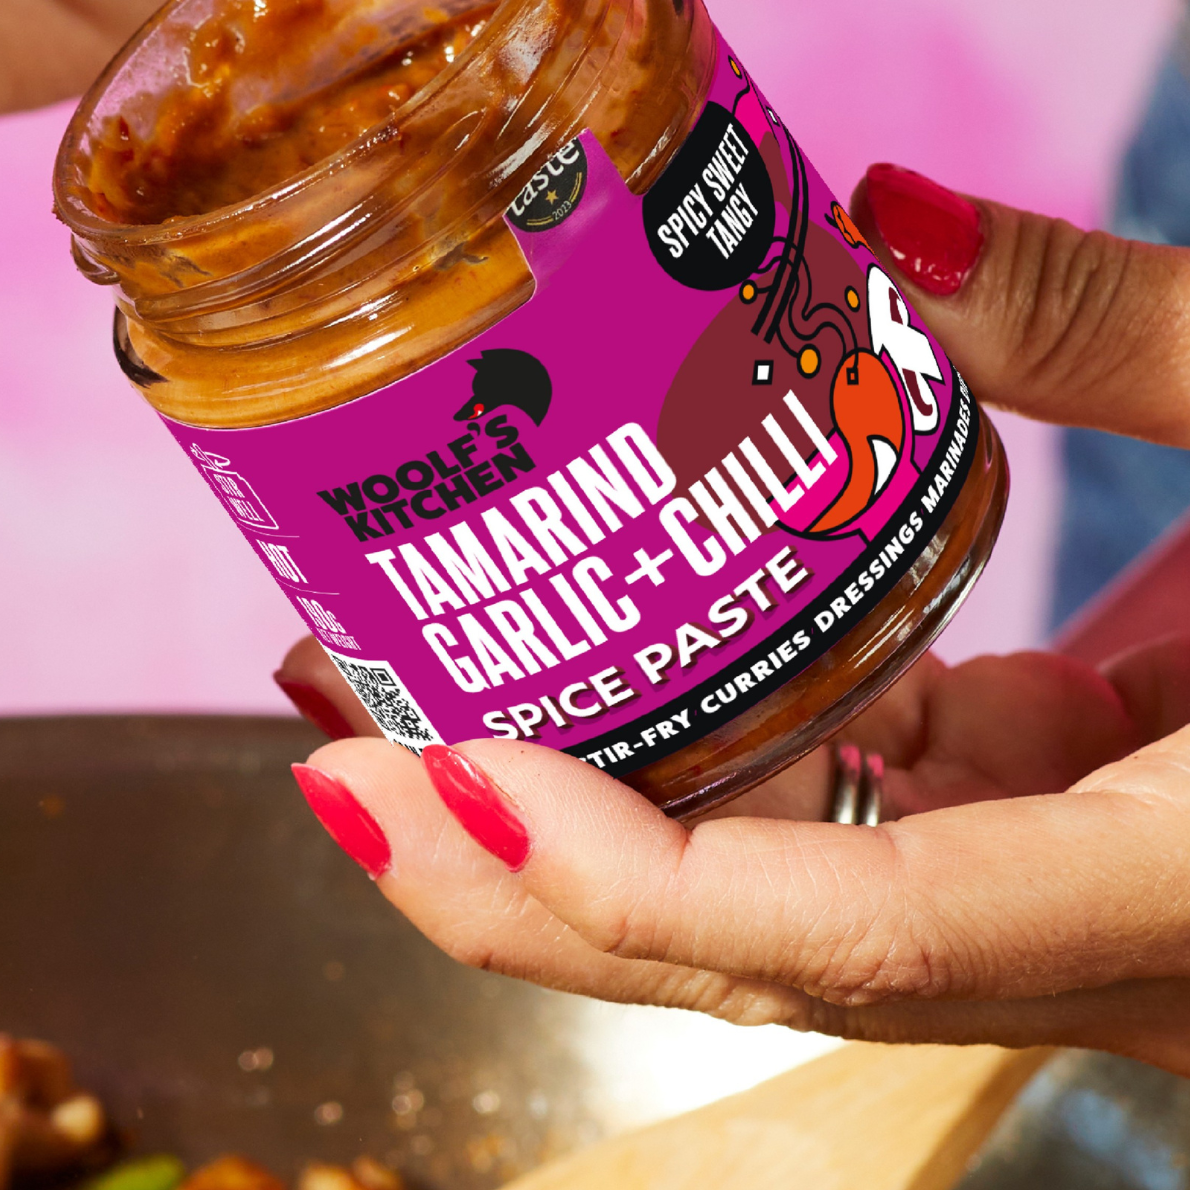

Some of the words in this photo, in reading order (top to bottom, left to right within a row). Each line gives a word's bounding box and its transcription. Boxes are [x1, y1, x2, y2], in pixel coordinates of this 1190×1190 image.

[552, 200, 572, 220] 2023
[657, 183, 714, 259] SPICY
[702, 123, 749, 202] SWEET
[705, 182, 758, 259] TANGY
[316, 414, 519, 516] WOOLF'S
[344, 442, 537, 542] KITCHEN
[365, 422, 677, 620] TAMARIND
[256, 539, 309, 584] HOT
[421, 556, 641, 693] GARLIC
[624, 548, 674, 587] +
[658, 389, 838, 577] CHILLI
[576, 708, 692, 770] TIR-FRY
[700, 629, 811, 714] CURRIES
[813, 511, 924, 632] DRESSINGS
[920, 398, 971, 513] MARINADES
[482, 666, 635, 740] SPICE
[633, 546, 809, 685] PASTE
